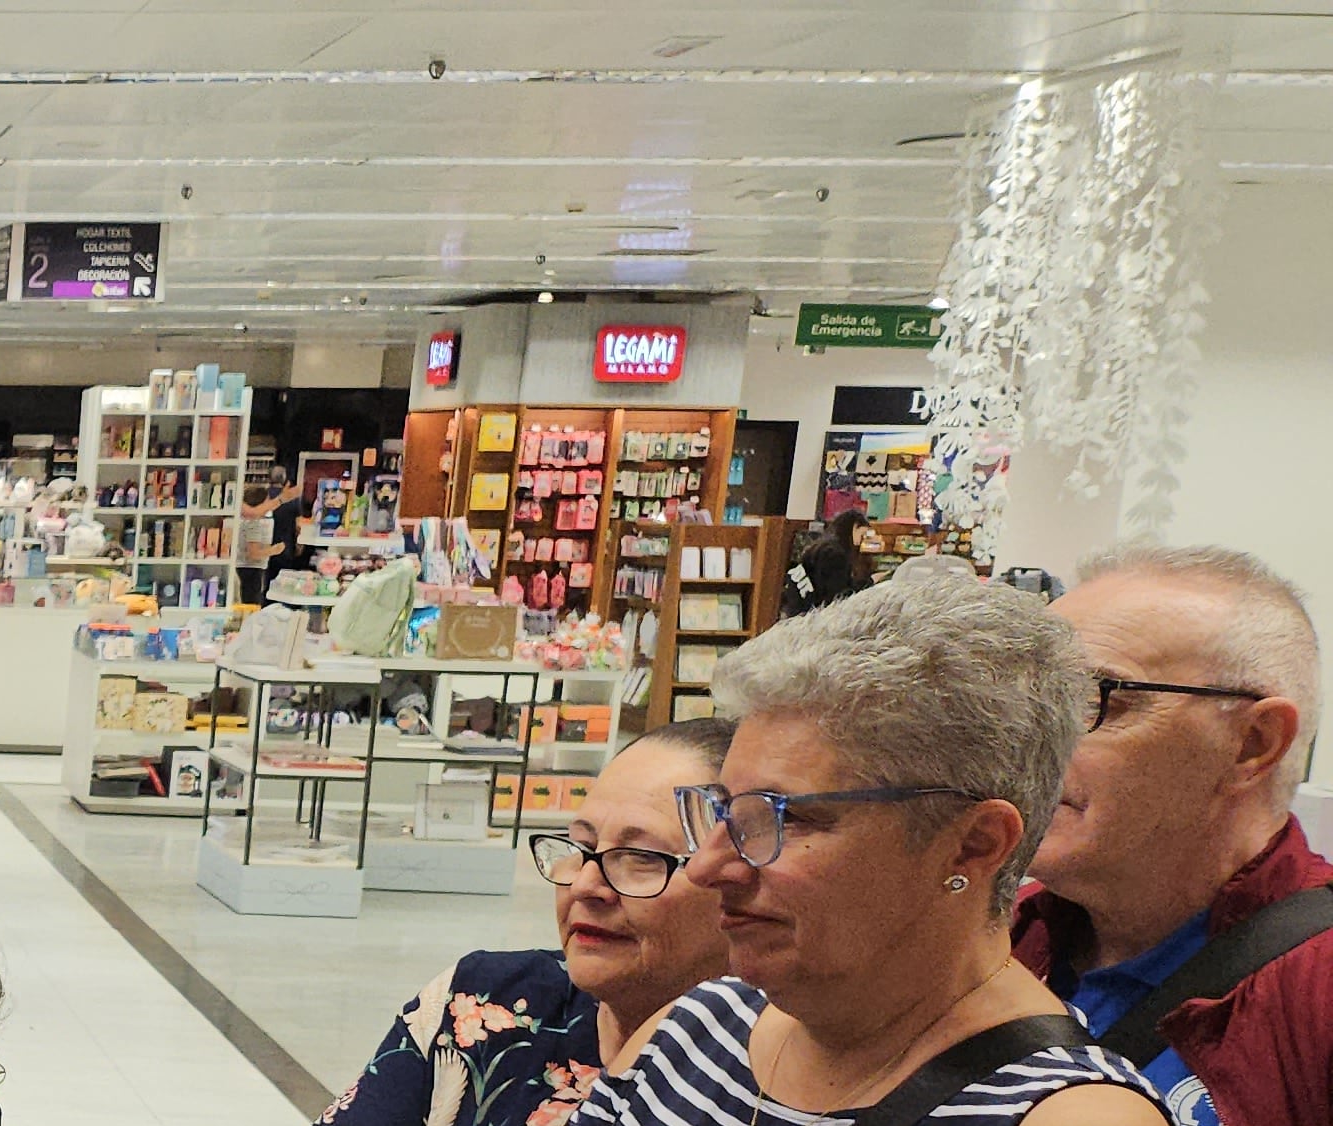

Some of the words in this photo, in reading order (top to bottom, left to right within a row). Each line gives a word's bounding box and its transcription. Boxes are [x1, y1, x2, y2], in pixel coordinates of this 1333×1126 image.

[28, 252, 49, 289] 2
[820, 313, 857, 325] Salida
[860, 313, 877, 325] de
[811, 323, 883, 338] Emergencia
[604, 332, 678, 364] LEGAMI
[607, 364, 669, 375] MILANO
